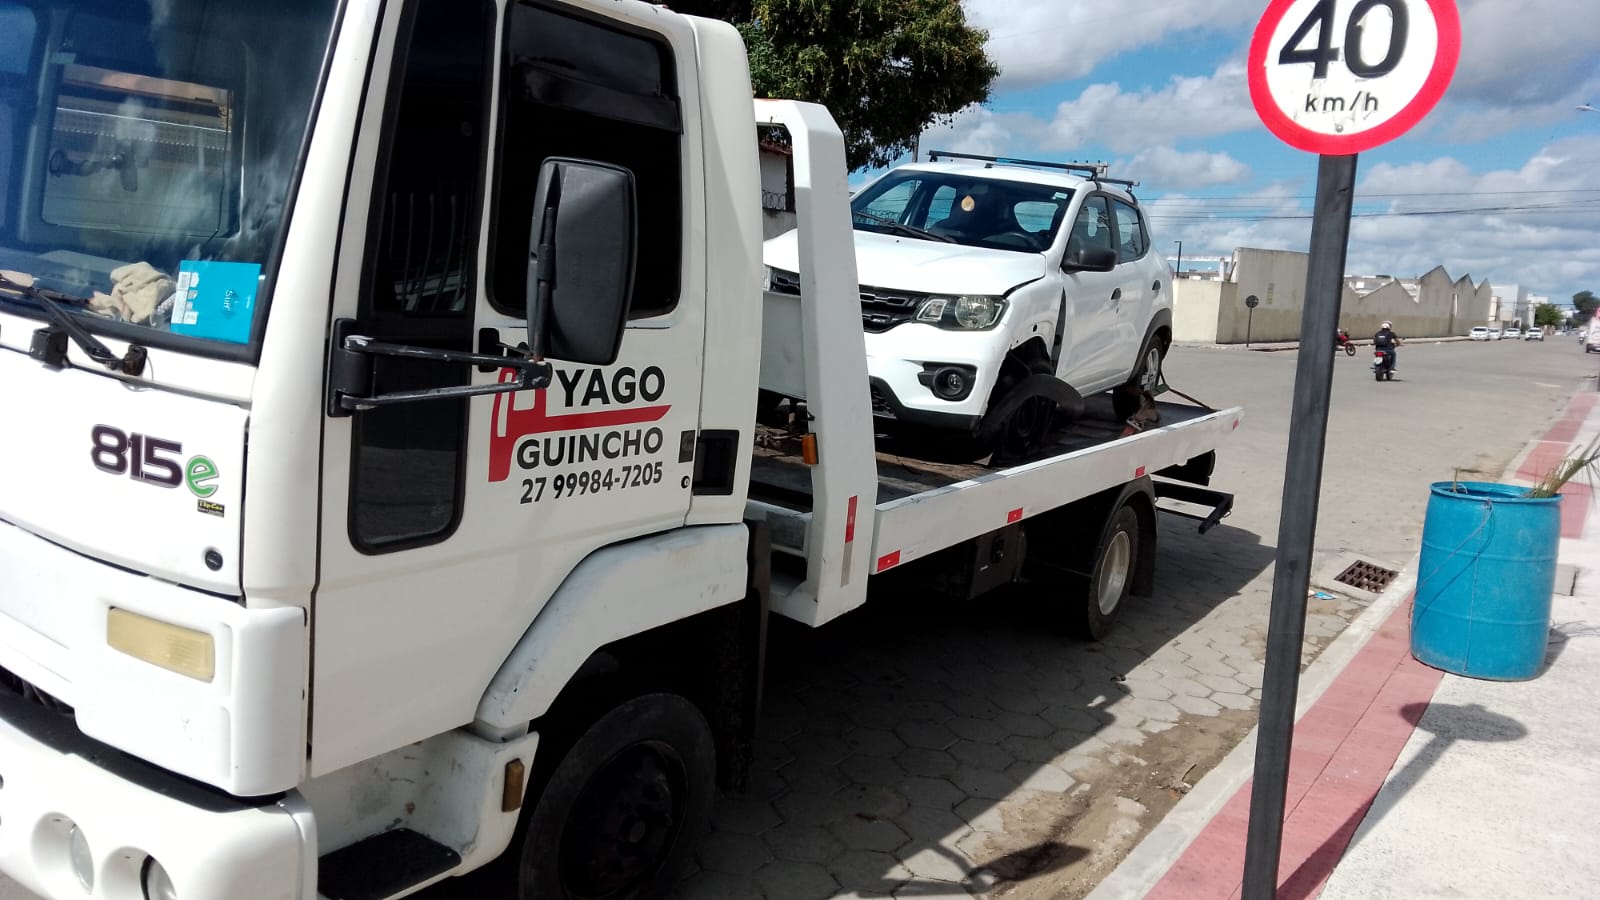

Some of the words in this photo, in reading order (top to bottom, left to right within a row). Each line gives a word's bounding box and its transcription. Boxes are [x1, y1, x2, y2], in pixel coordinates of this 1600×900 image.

[1278, 0, 1410, 79] 40
[1304, 90, 1379, 112] km/h
[556, 366, 665, 407] YAGO
[516, 427, 663, 470] GUINCHO
[520, 477, 547, 504] 27
[553, 461, 663, 499] 99984-7205
